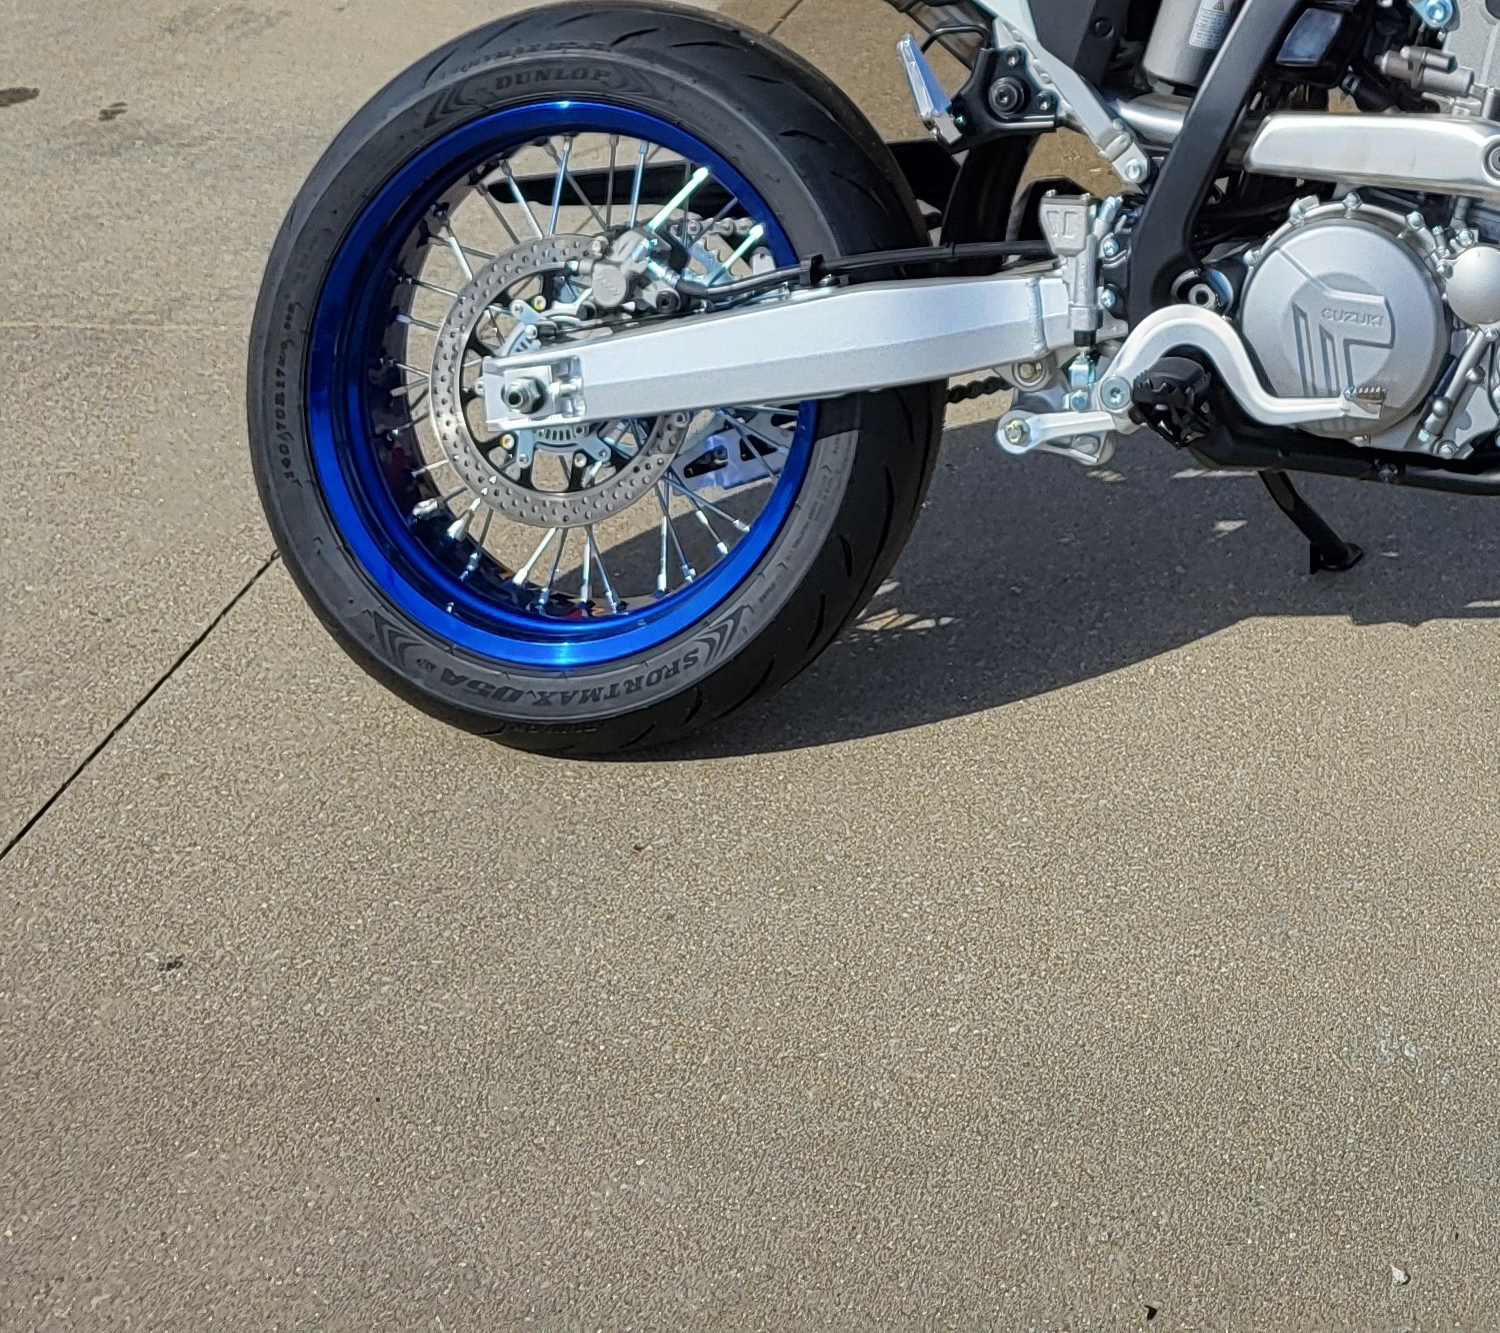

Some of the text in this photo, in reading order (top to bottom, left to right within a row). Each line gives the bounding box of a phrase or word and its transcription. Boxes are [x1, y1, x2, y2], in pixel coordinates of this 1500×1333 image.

[495, 66, 611, 91] DUNLOP
[1321, 308, 1385, 327] SUZUKI
[532, 646, 700, 708] SPORTMAX
